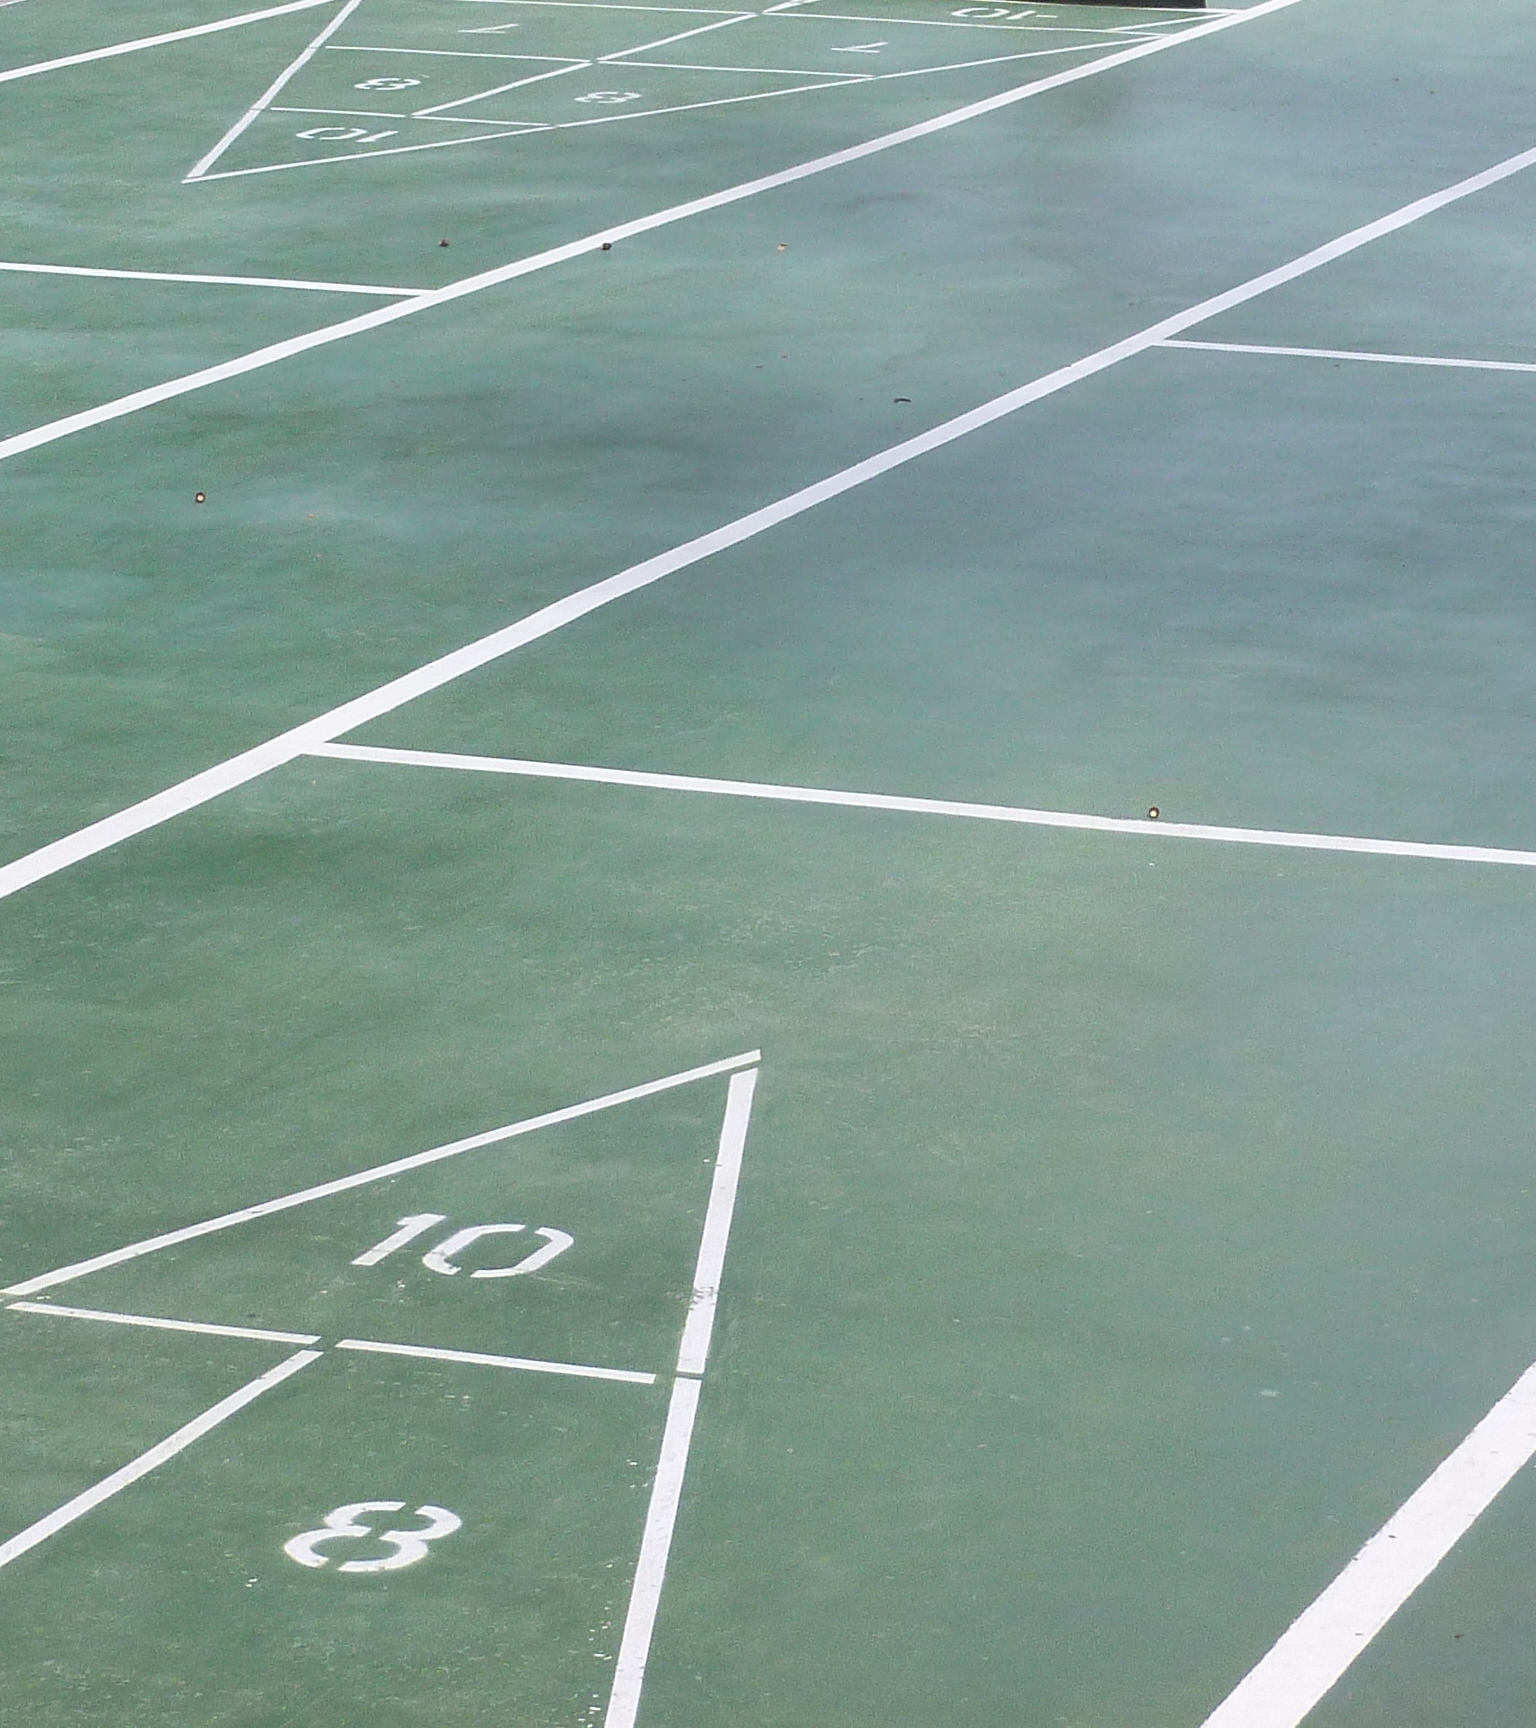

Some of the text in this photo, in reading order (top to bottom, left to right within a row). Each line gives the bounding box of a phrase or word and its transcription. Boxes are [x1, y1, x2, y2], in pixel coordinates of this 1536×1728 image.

[459, 22, 518, 35] 7
[832, 41, 890, 54] 7
[354, 77, 422, 91] 8
[574, 90, 642, 105] 8
[295, 127, 399, 142] 10
[349, 1213, 576, 1278] 10
[279, 1498, 465, 1573] 8
